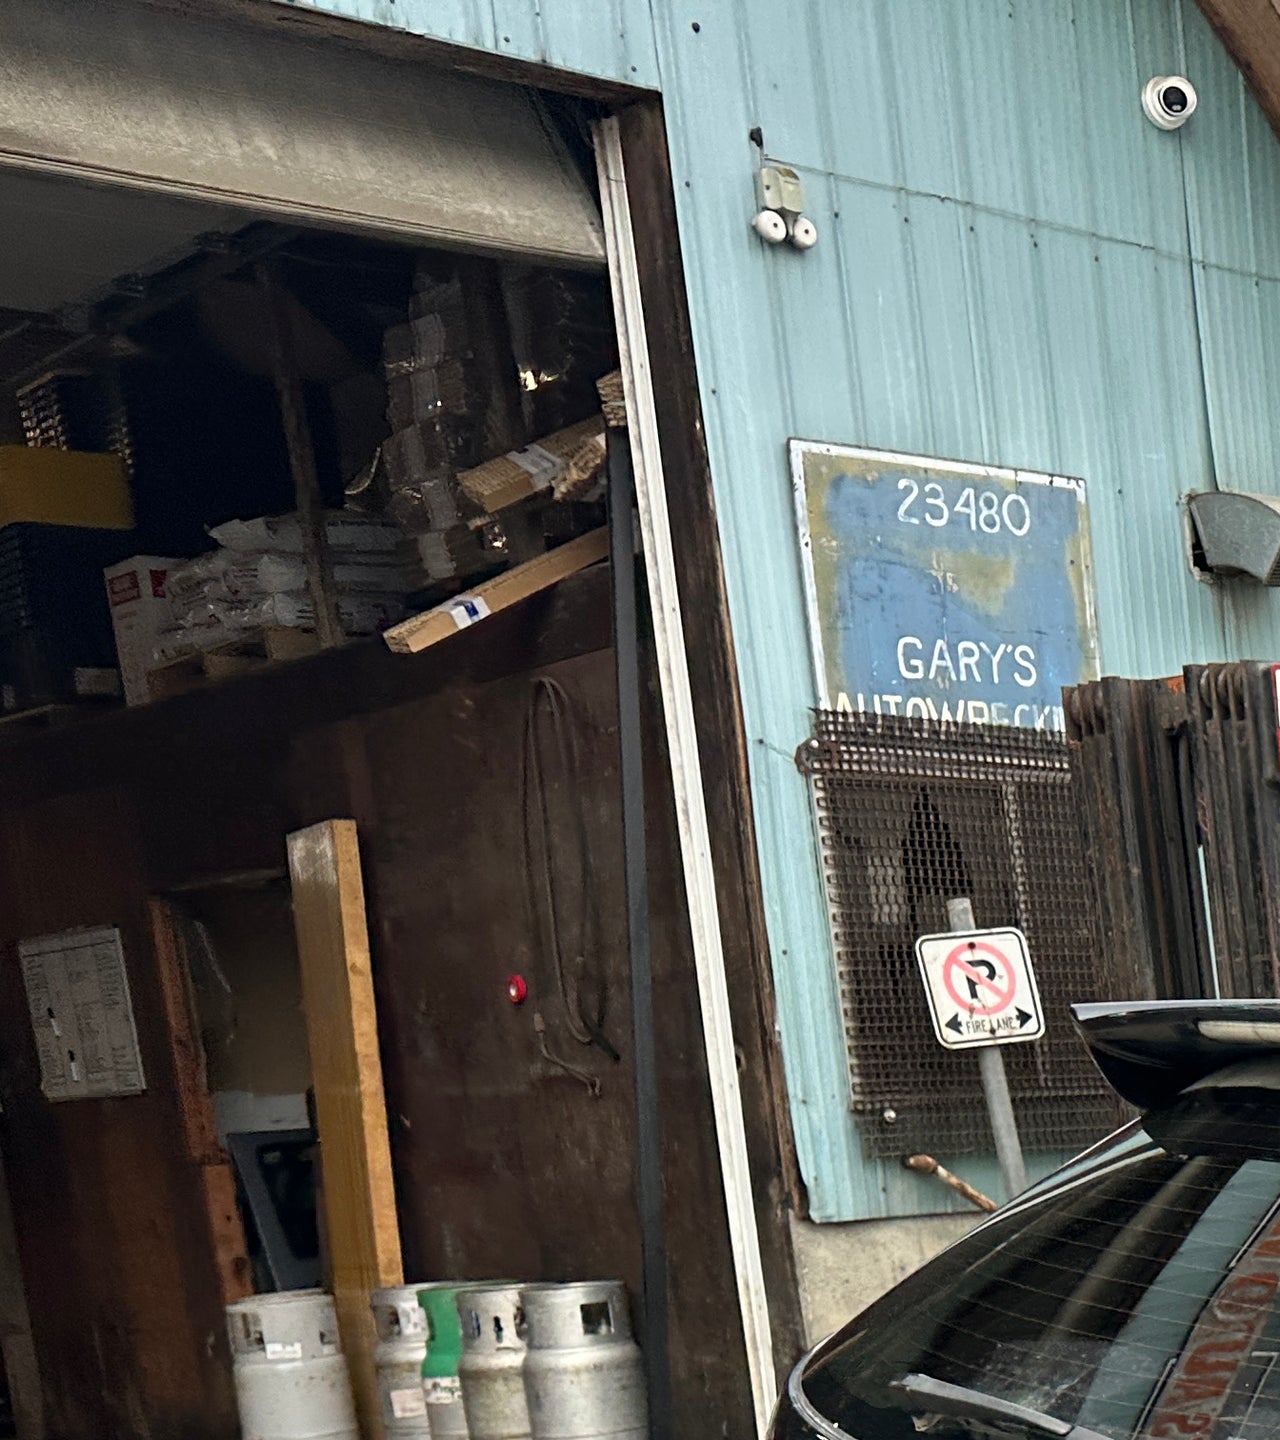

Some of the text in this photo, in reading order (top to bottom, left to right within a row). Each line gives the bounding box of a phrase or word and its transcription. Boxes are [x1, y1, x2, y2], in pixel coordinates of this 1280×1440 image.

[897, 479, 1031, 537] 23480
[897, 636, 1037, 687] GARY'S
[965, 1019, 987, 1034] FIRE
